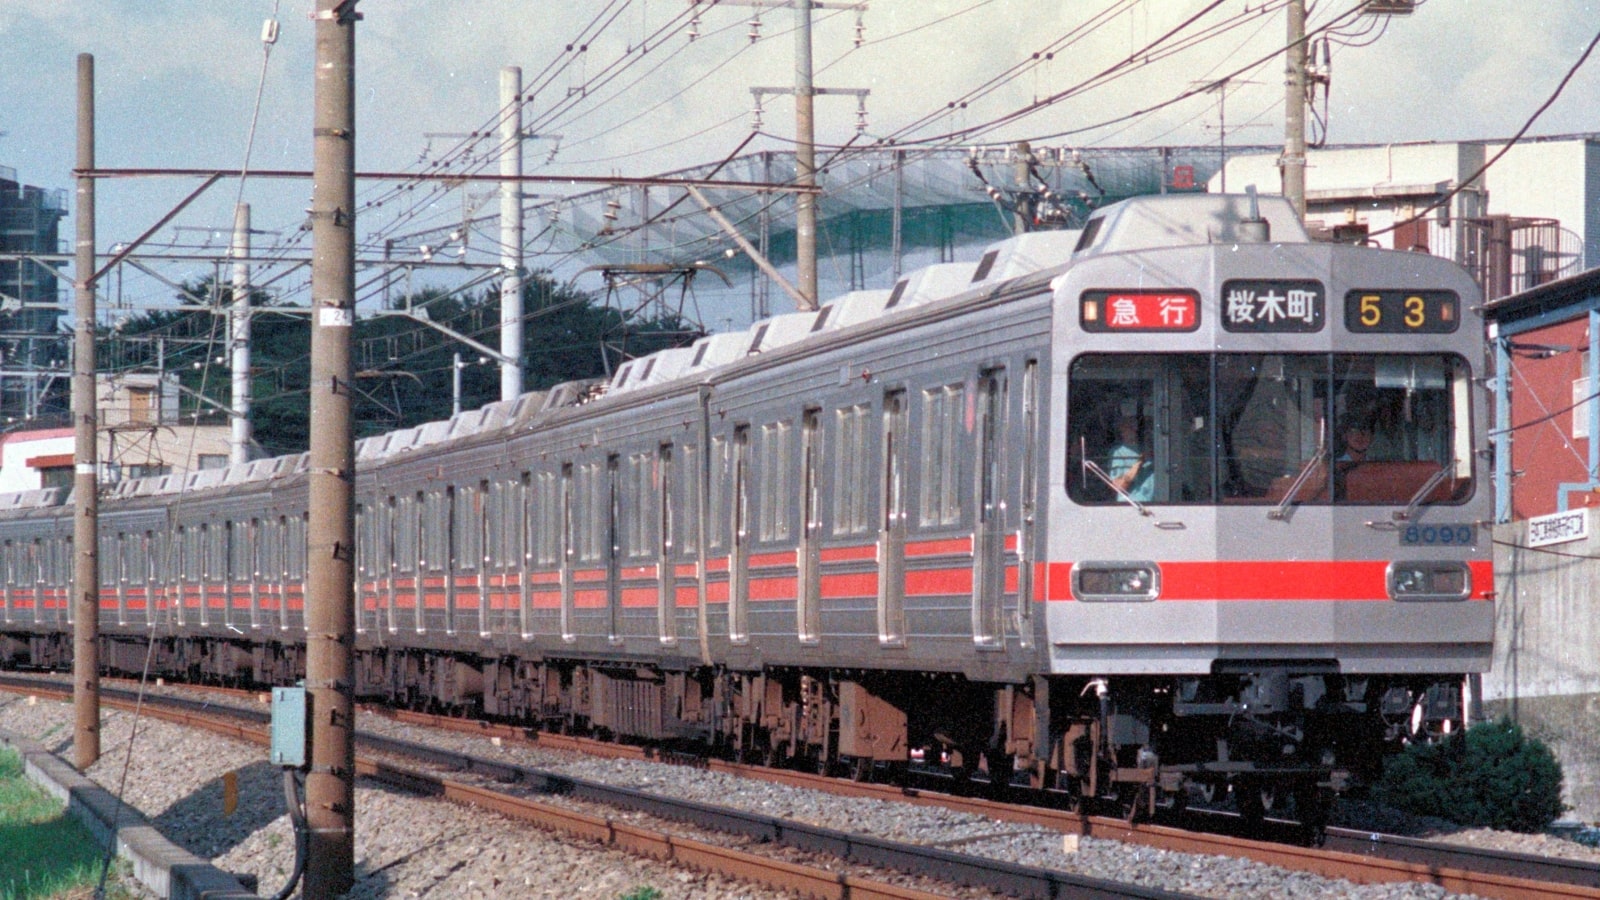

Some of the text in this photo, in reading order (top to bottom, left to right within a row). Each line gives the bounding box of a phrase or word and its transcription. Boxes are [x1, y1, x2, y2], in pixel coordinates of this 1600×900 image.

[1112, 297, 1188, 325] 急行
[1227, 289, 1318, 323] 桜木町
[1405, 525, 1472, 544] 8090
